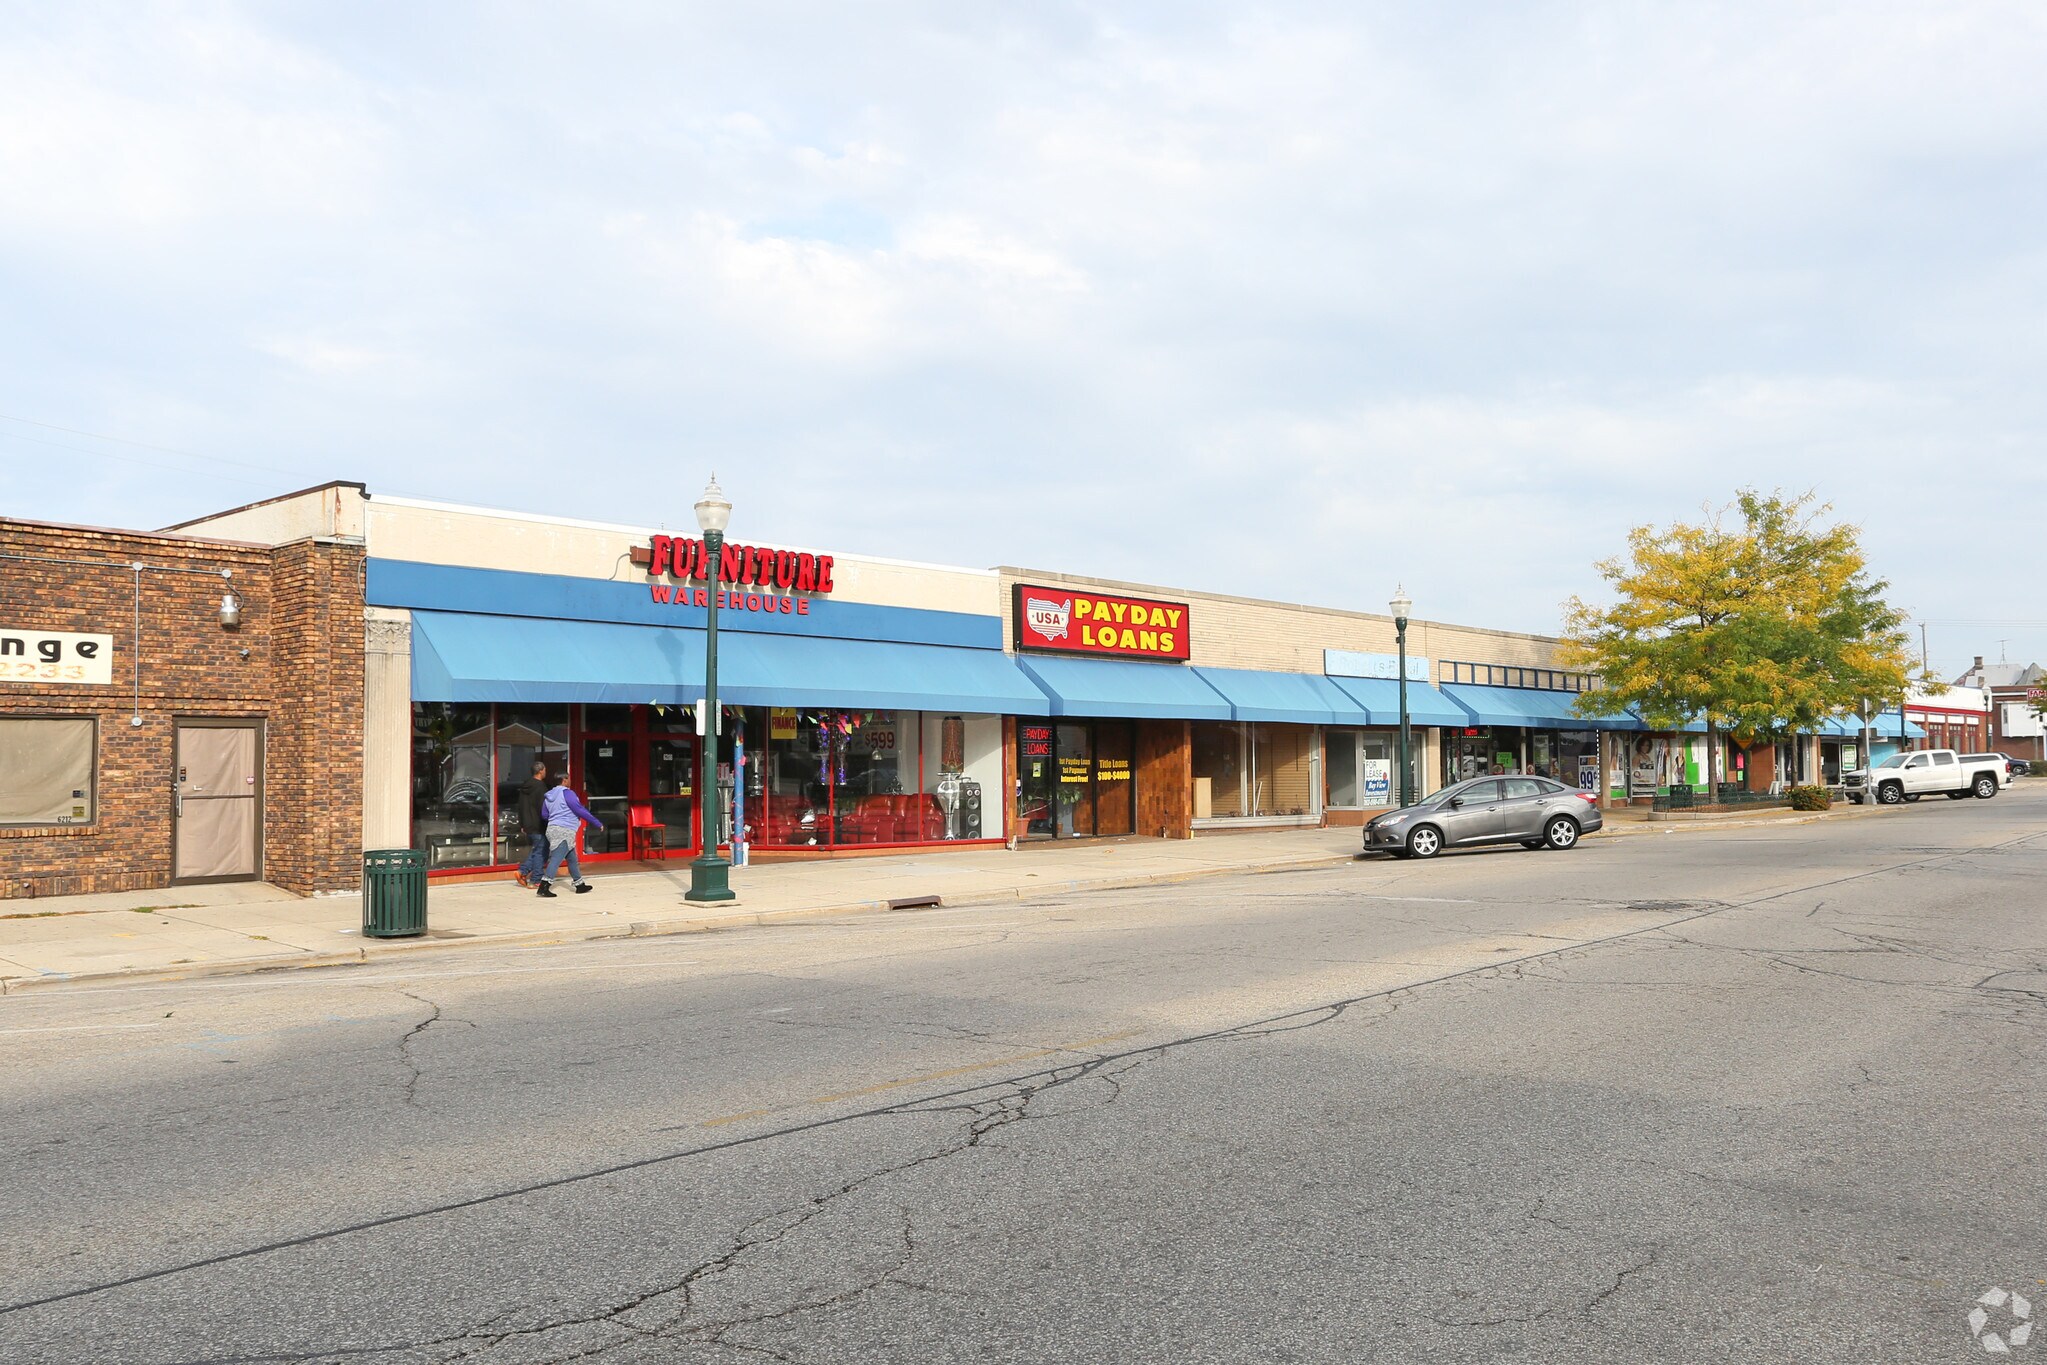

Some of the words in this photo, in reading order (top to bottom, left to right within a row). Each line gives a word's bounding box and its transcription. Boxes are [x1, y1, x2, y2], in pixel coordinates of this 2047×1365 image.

[1036, 612, 1060, 625] USA
[1074, 598, 1182, 629] PAYDAY
[1082, 625, 1175, 653] LOANS
[1, 637, 99, 663] nge
[772, 716, 796, 730] FINANCE
[865, 731, 895, 750] $599
[1026, 728, 1050, 740] PAYDAY
[1027, 743, 1049, 755] LOANS
[1099, 760, 1111, 768] Title
[1112, 760, 1128, 768] Loans
[1366, 761, 1377, 770] FOR
[1366, 770, 1382, 778] LEASE
